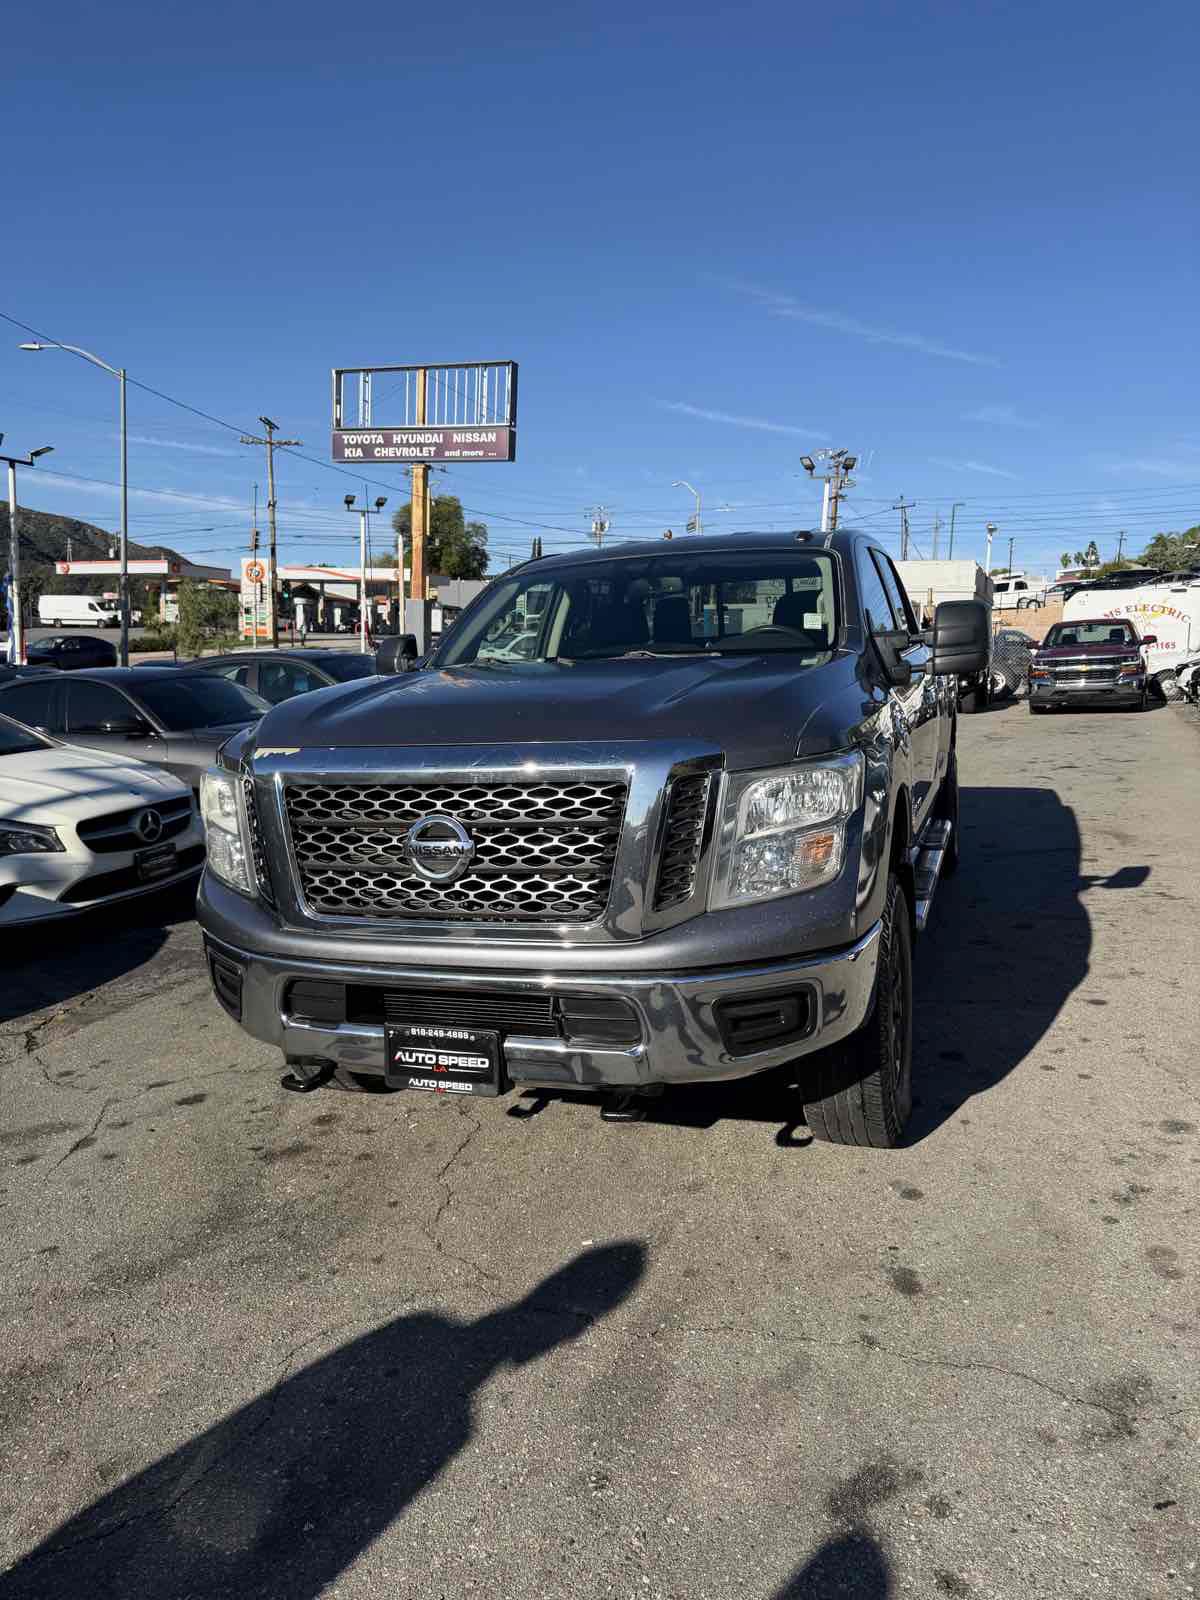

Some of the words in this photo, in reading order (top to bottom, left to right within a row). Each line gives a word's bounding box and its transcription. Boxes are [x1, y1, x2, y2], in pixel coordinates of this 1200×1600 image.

[342, 434, 384, 445] TOYOTA
[392, 433, 444, 444] HYUNDAI
[452, 432, 497, 443] NISSAN
[344, 447, 364, 457] KIA
[374, 446, 437, 457] CHEVROLET
[444, 449, 460, 457] and
[1125, 603, 1192, 623] ELECTRIC
[408, 845, 465, 857] NISSAN
[394, 1051, 437, 1064] AUTO
[438, 1054, 490, 1069] SPEED
[408, 1078, 438, 1088] AUTO
[438, 1080, 473, 1091] SPEED
